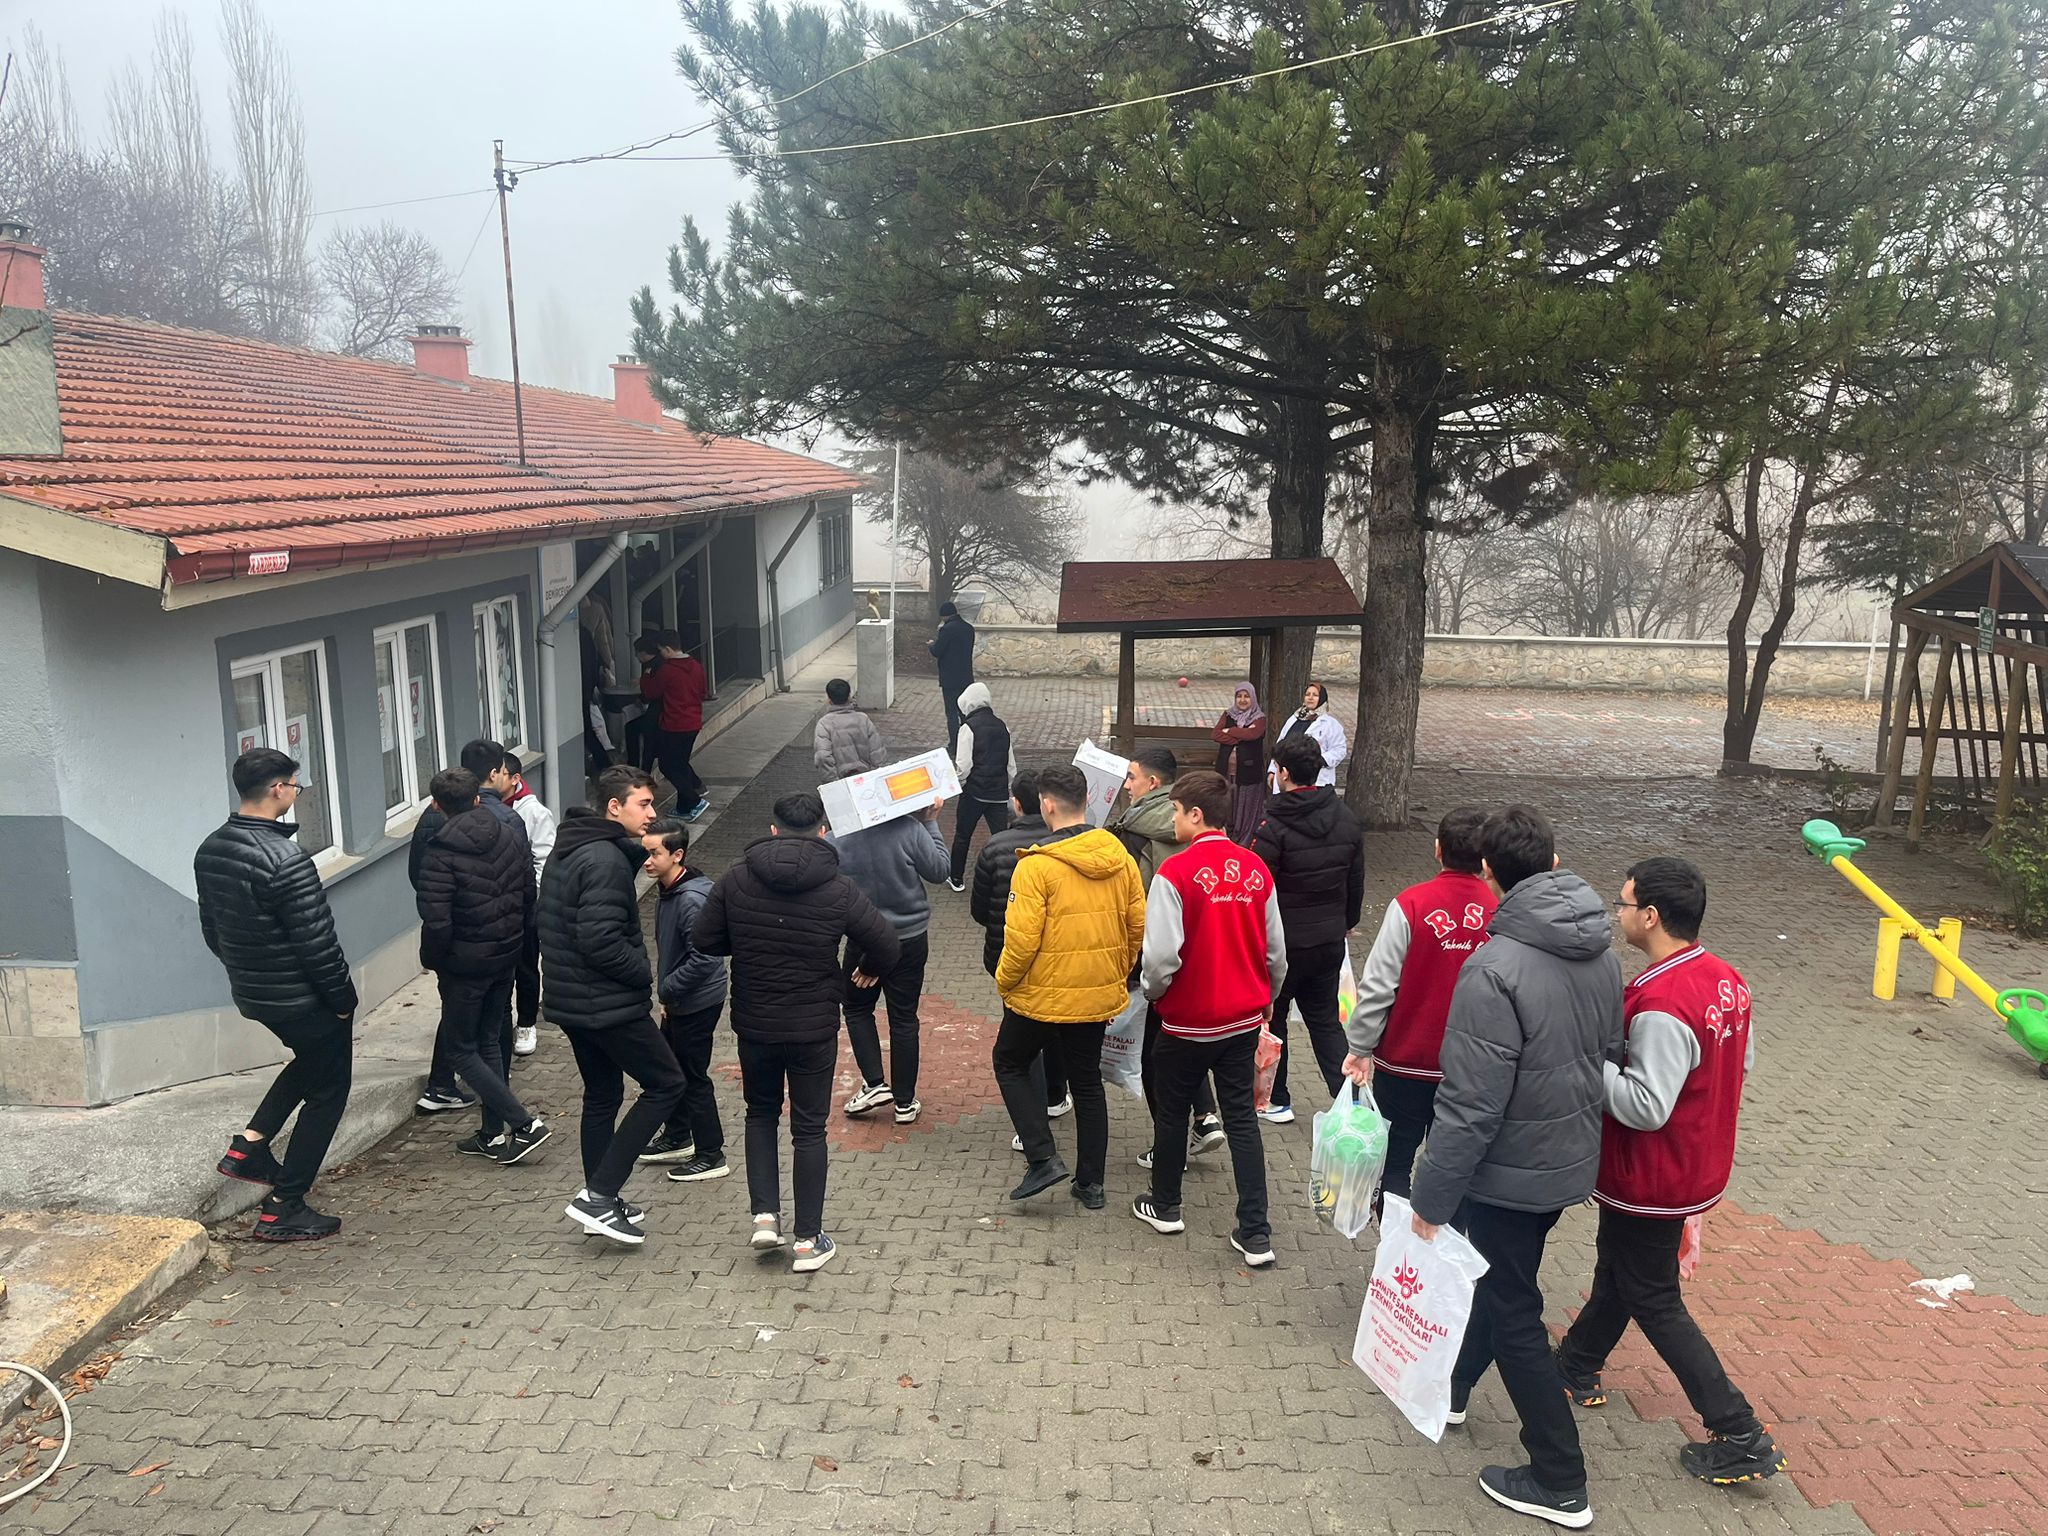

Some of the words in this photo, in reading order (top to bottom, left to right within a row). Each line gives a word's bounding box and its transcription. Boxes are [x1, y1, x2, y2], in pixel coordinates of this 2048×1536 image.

[1193, 858, 1264, 894] RSP
[1424, 903, 1492, 938] RS
[1413, 1313, 1448, 1337] PALALI
